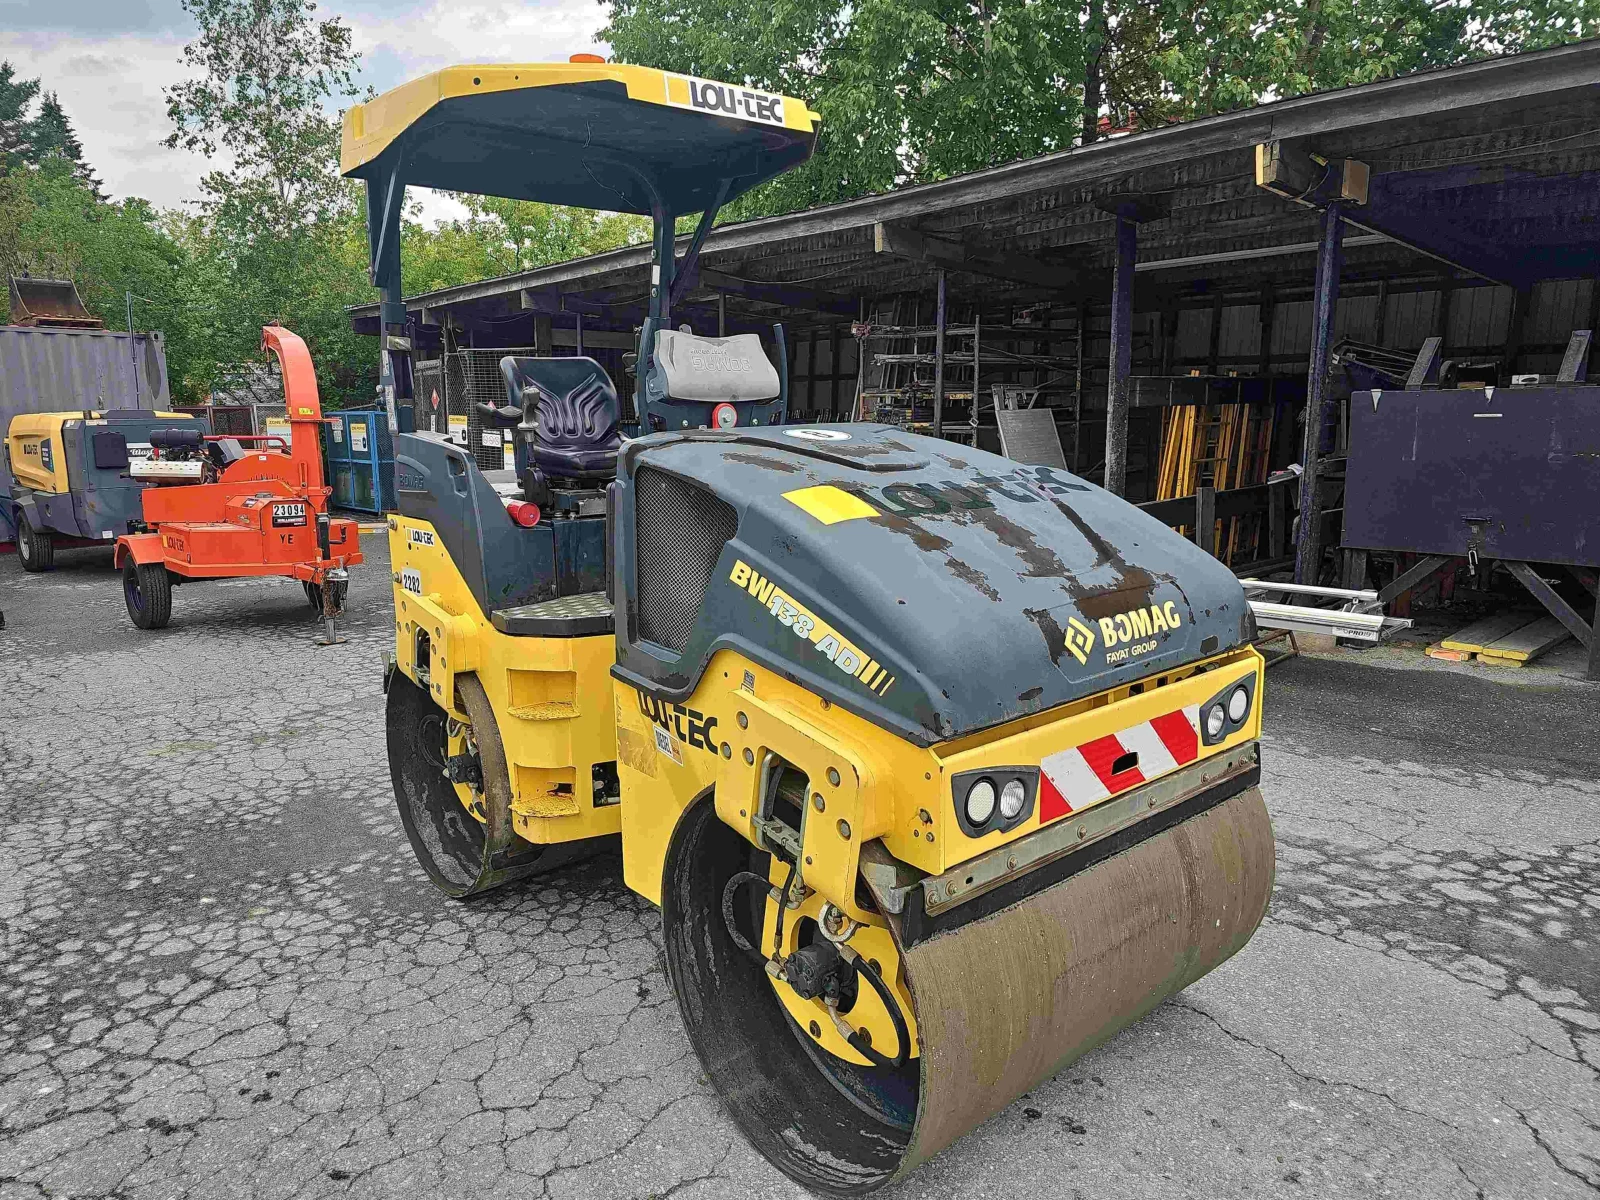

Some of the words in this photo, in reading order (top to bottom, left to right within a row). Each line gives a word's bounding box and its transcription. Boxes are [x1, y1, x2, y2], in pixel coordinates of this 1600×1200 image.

[690, 81, 783, 123] LOU-TEC
[273, 504, 304, 516] 23094
[280, 534, 294, 544] YE
[412, 530, 434, 545] LOU-TEC
[403, 574, 421, 594] 2282
[1098, 600, 1181, 648] BOMAG
[814, 634, 861, 675] AD
[1106, 648, 1130, 665] FAYAT
[1131, 640, 1158, 656] GROUP
[636, 690, 719, 755] LOU-TEC
